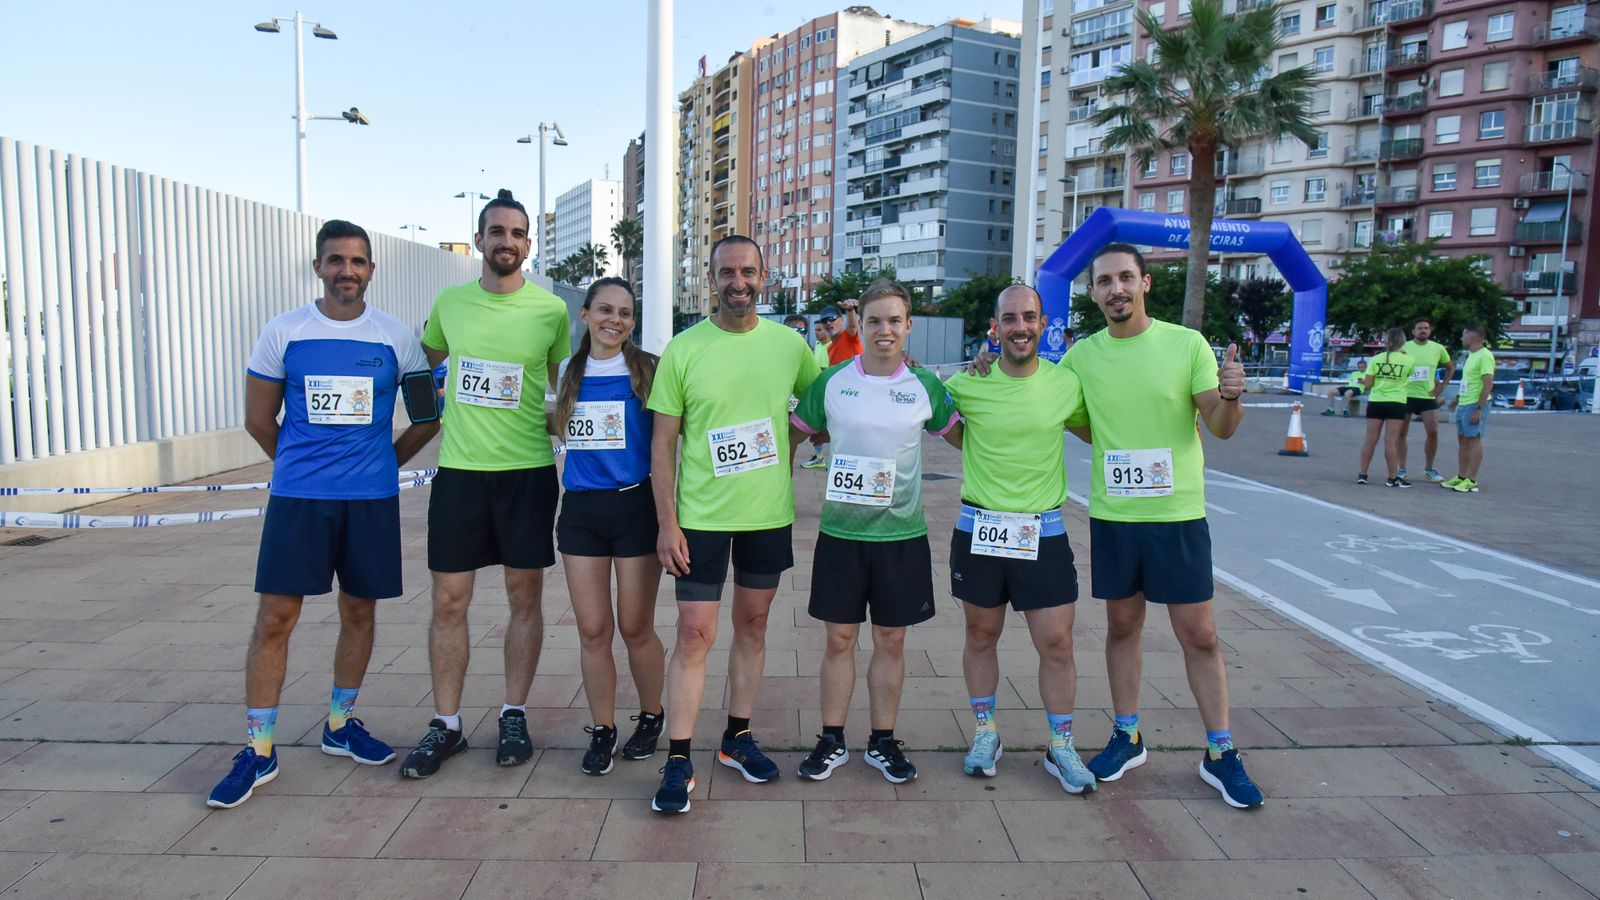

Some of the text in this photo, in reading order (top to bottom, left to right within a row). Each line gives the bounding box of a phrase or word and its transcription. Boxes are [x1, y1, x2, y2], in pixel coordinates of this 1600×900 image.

[1164, 218, 1250, 233] AYUMIENTO
[1168, 233, 1245, 246] DE ACIRAS
[461, 360, 473, 369] XXI
[1376, 363, 1405, 378] XXI
[308, 380, 320, 388] XXI
[462, 374, 490, 394] 674
[840, 388, 860, 397] vive
[311, 393, 342, 410] 527
[568, 419, 594, 436] 628
[711, 432, 724, 441] XXI
[716, 441, 748, 463] 652
[834, 457, 847, 466] XXI
[833, 471, 864, 491] 654
[1113, 467, 1144, 484] 913
[978, 526, 1009, 544] 604
